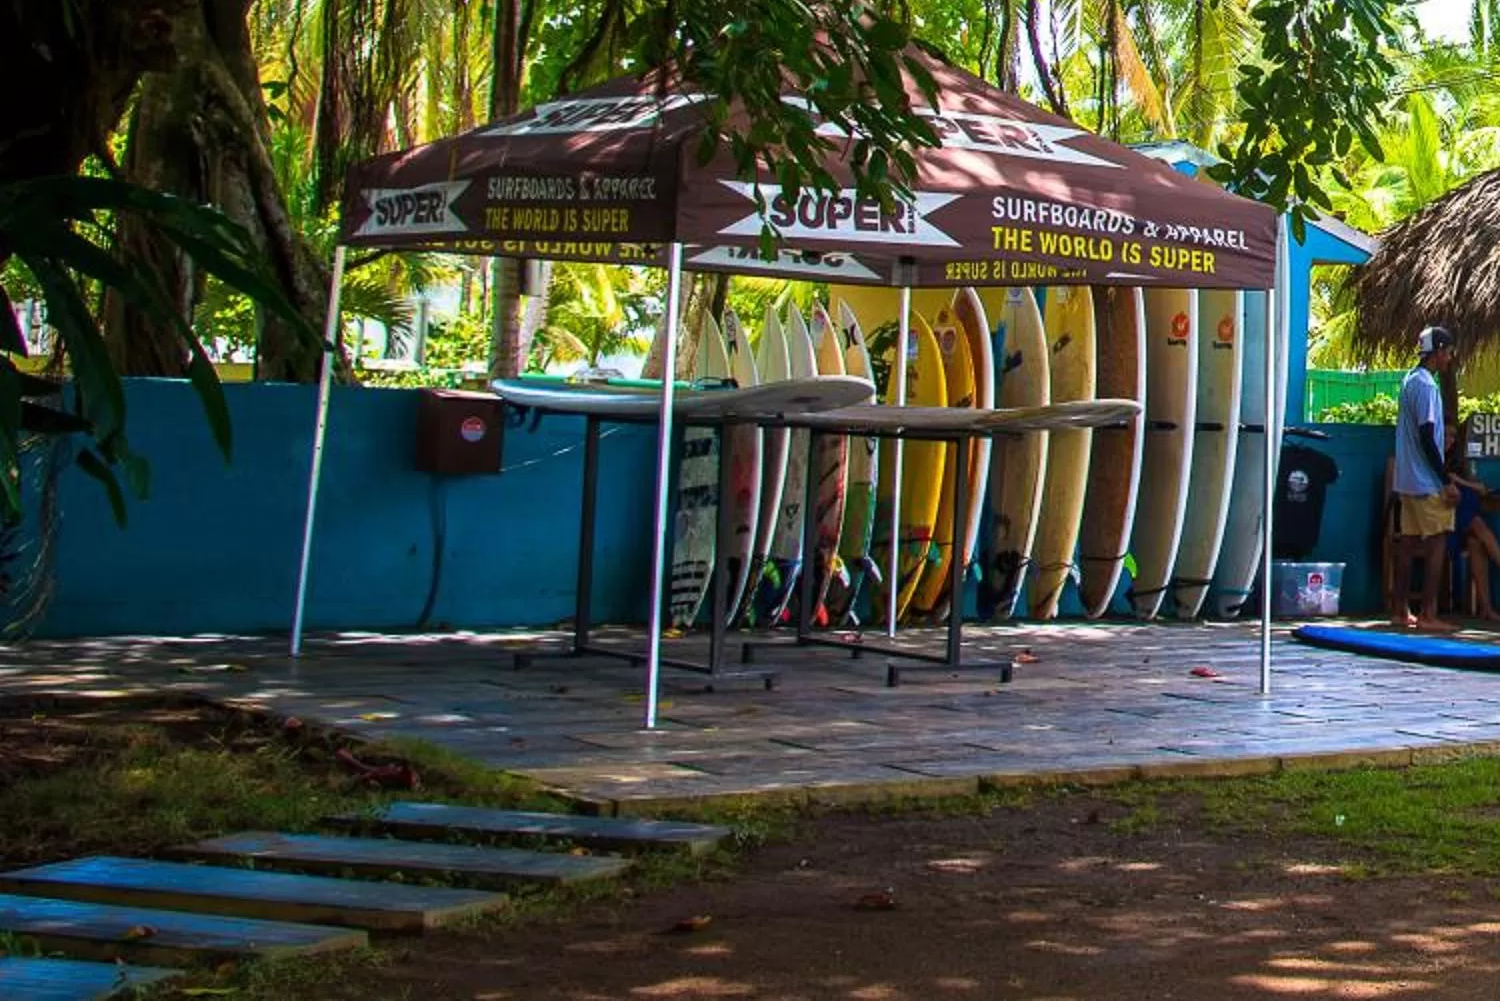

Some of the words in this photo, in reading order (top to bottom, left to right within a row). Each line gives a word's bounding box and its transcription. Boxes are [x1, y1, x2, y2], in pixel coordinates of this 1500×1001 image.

[487, 177, 576, 199] SURFBOARDS
[594, 177, 657, 199] APPAREL
[485, 207, 510, 230] THE
[512, 207, 560, 231] WORLD
[564, 208, 578, 231] IS
[582, 208, 630, 232] SUPER
[991, 196, 1136, 235] SURFBOARDS
[1143, 220, 1160, 238] &
[1164, 224, 1249, 250] APPAREL
[991, 226, 1033, 253] THE
[1039, 232, 1113, 261] WORLD
[1121, 242, 1142, 264] IS
[1149, 246, 1216, 274] SUPER
